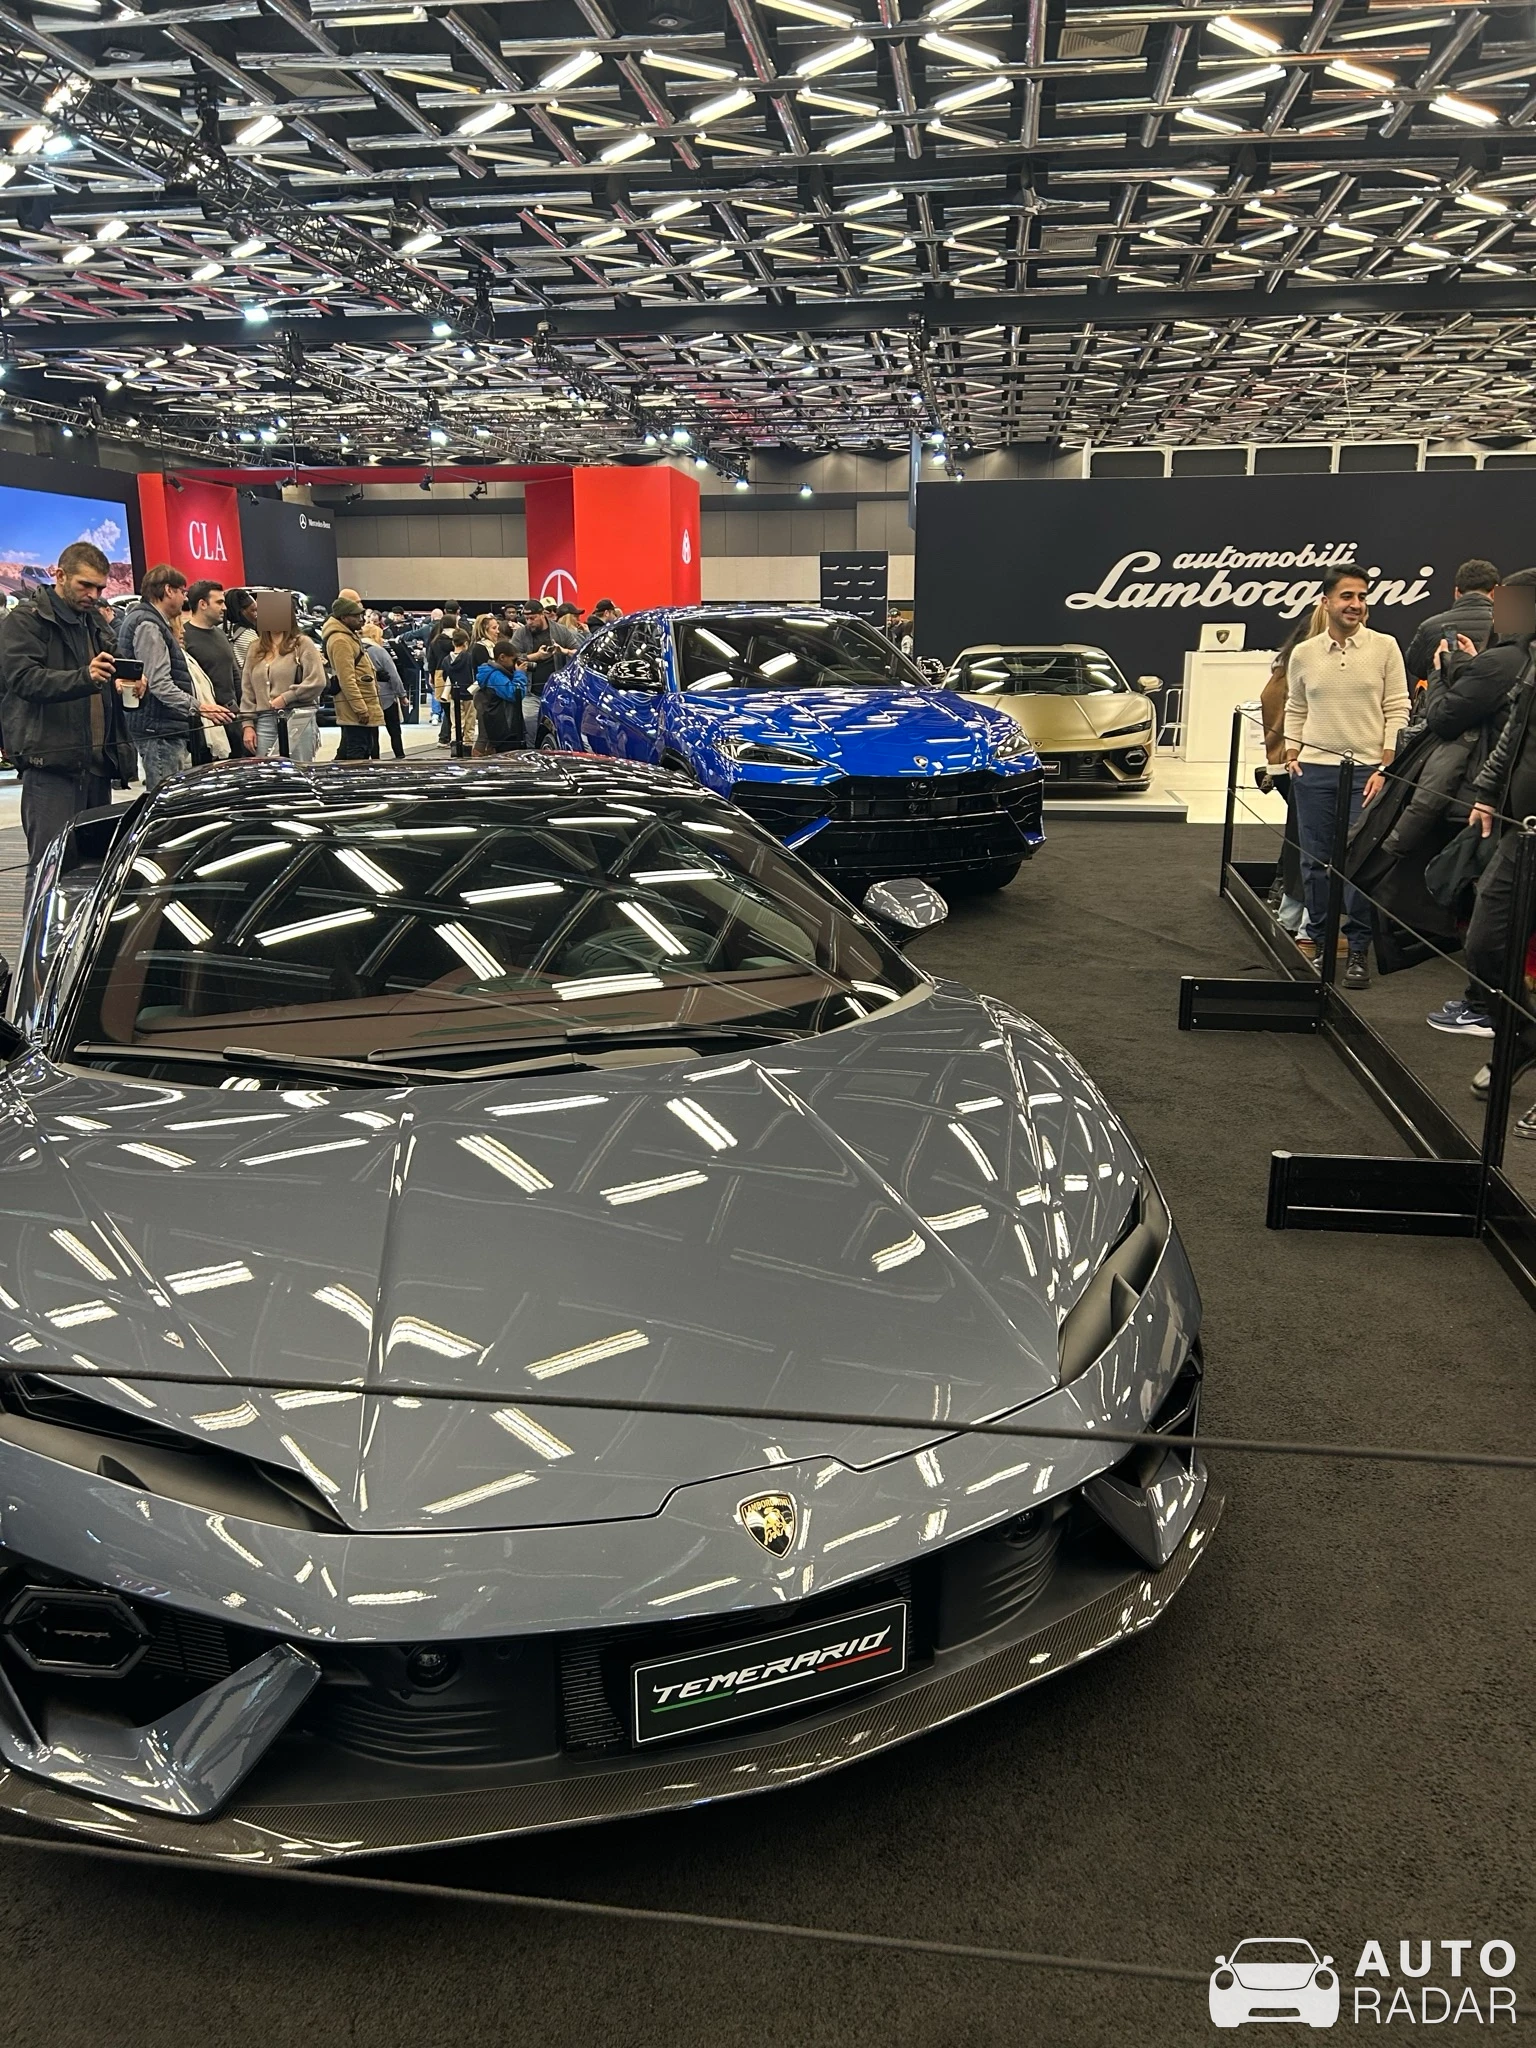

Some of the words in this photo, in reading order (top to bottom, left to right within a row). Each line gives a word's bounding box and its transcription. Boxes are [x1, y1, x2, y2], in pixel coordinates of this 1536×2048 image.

[188, 520, 228, 562] CLA
[1172, 542, 1358, 569] automobili
[1065, 550, 1434, 620] Lamborgini
[652, 1624, 892, 1704] TEMERARIO
